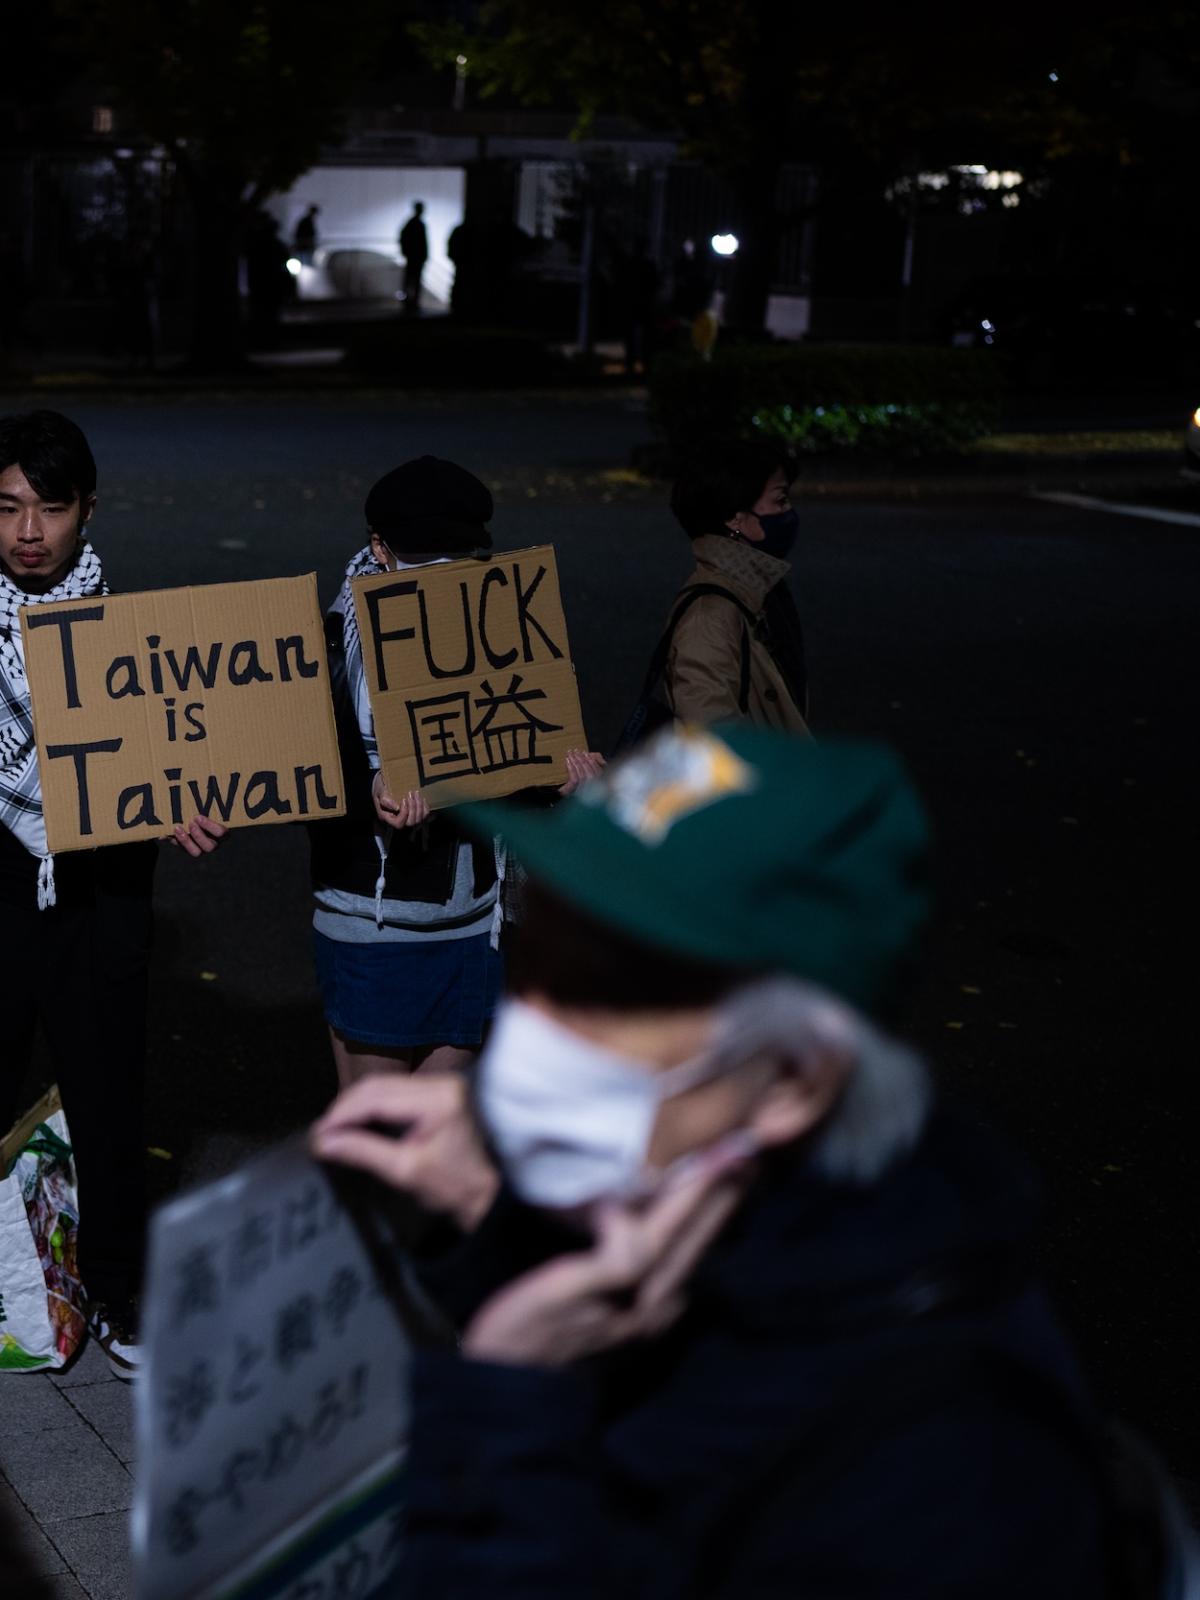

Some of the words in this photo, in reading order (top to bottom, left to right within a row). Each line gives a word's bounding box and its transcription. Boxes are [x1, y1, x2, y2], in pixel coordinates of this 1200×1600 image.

[27, 604, 319, 709] Taiwan
[364, 563, 564, 691] FUCK
[163, 697, 207, 742] is
[405, 674, 564, 788] 国益
[46, 737, 338, 835] Taiwan
